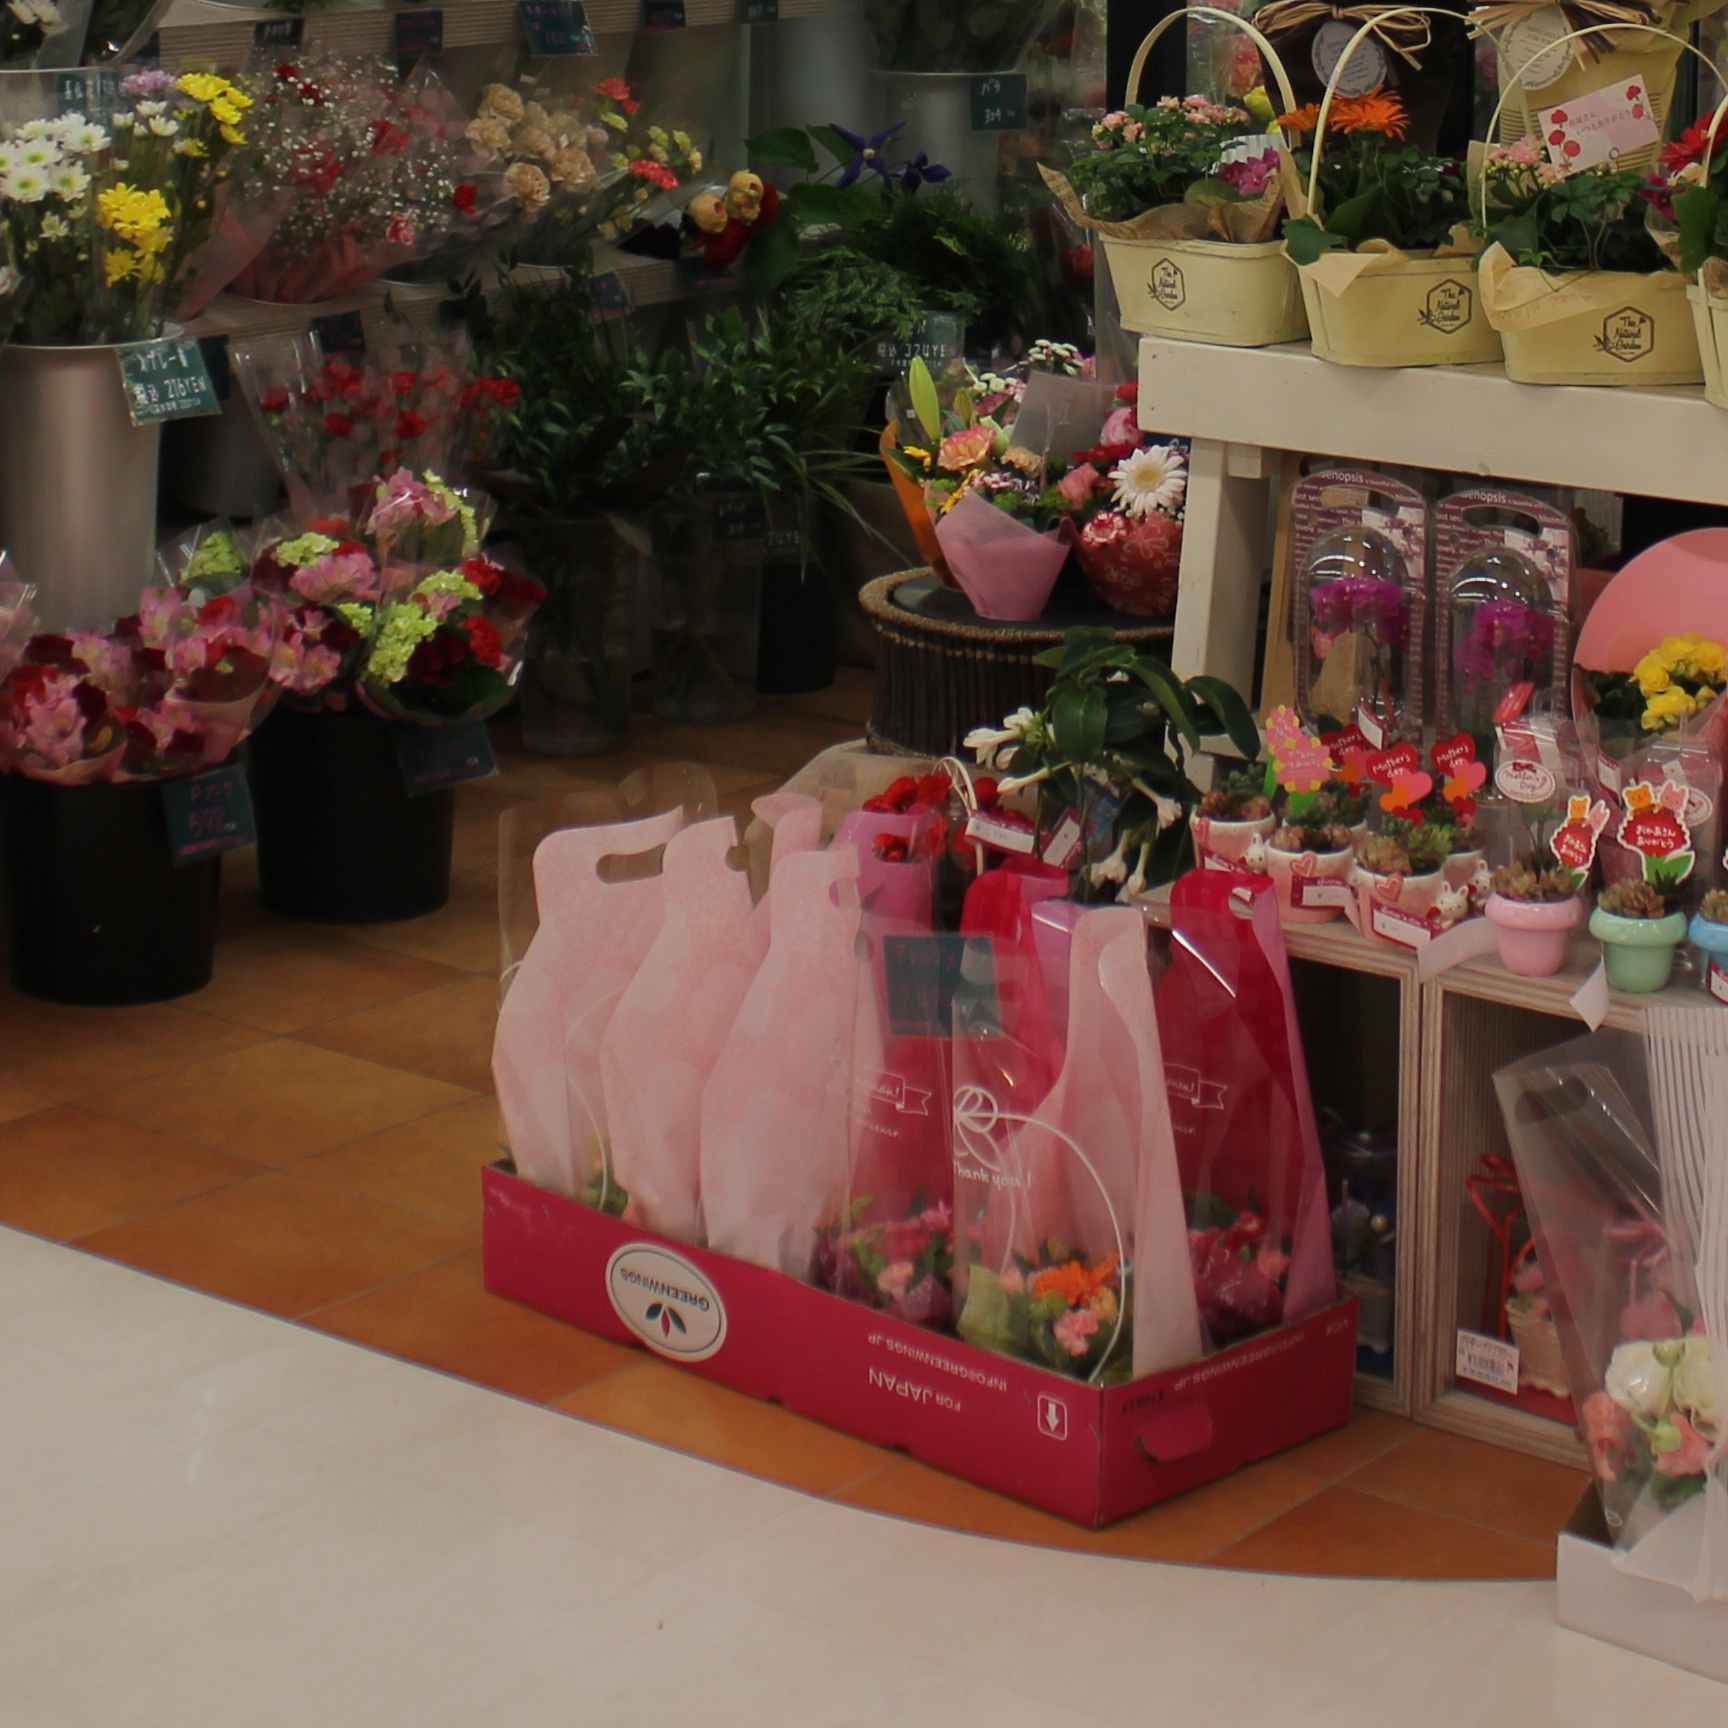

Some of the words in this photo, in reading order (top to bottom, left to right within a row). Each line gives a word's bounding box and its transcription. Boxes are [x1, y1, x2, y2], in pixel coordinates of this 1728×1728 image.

[1372, 752, 1411, 775] Mother's
[1436, 742, 1470, 765] Mother's
[1449, 758, 1463, 769] day
[1387, 767, 1404, 779] day
[620, 1267, 710, 1313] GREENWINGS
[868, 1367, 933, 1405] JAPAN
[935, 1393, 962, 1413] FOR
